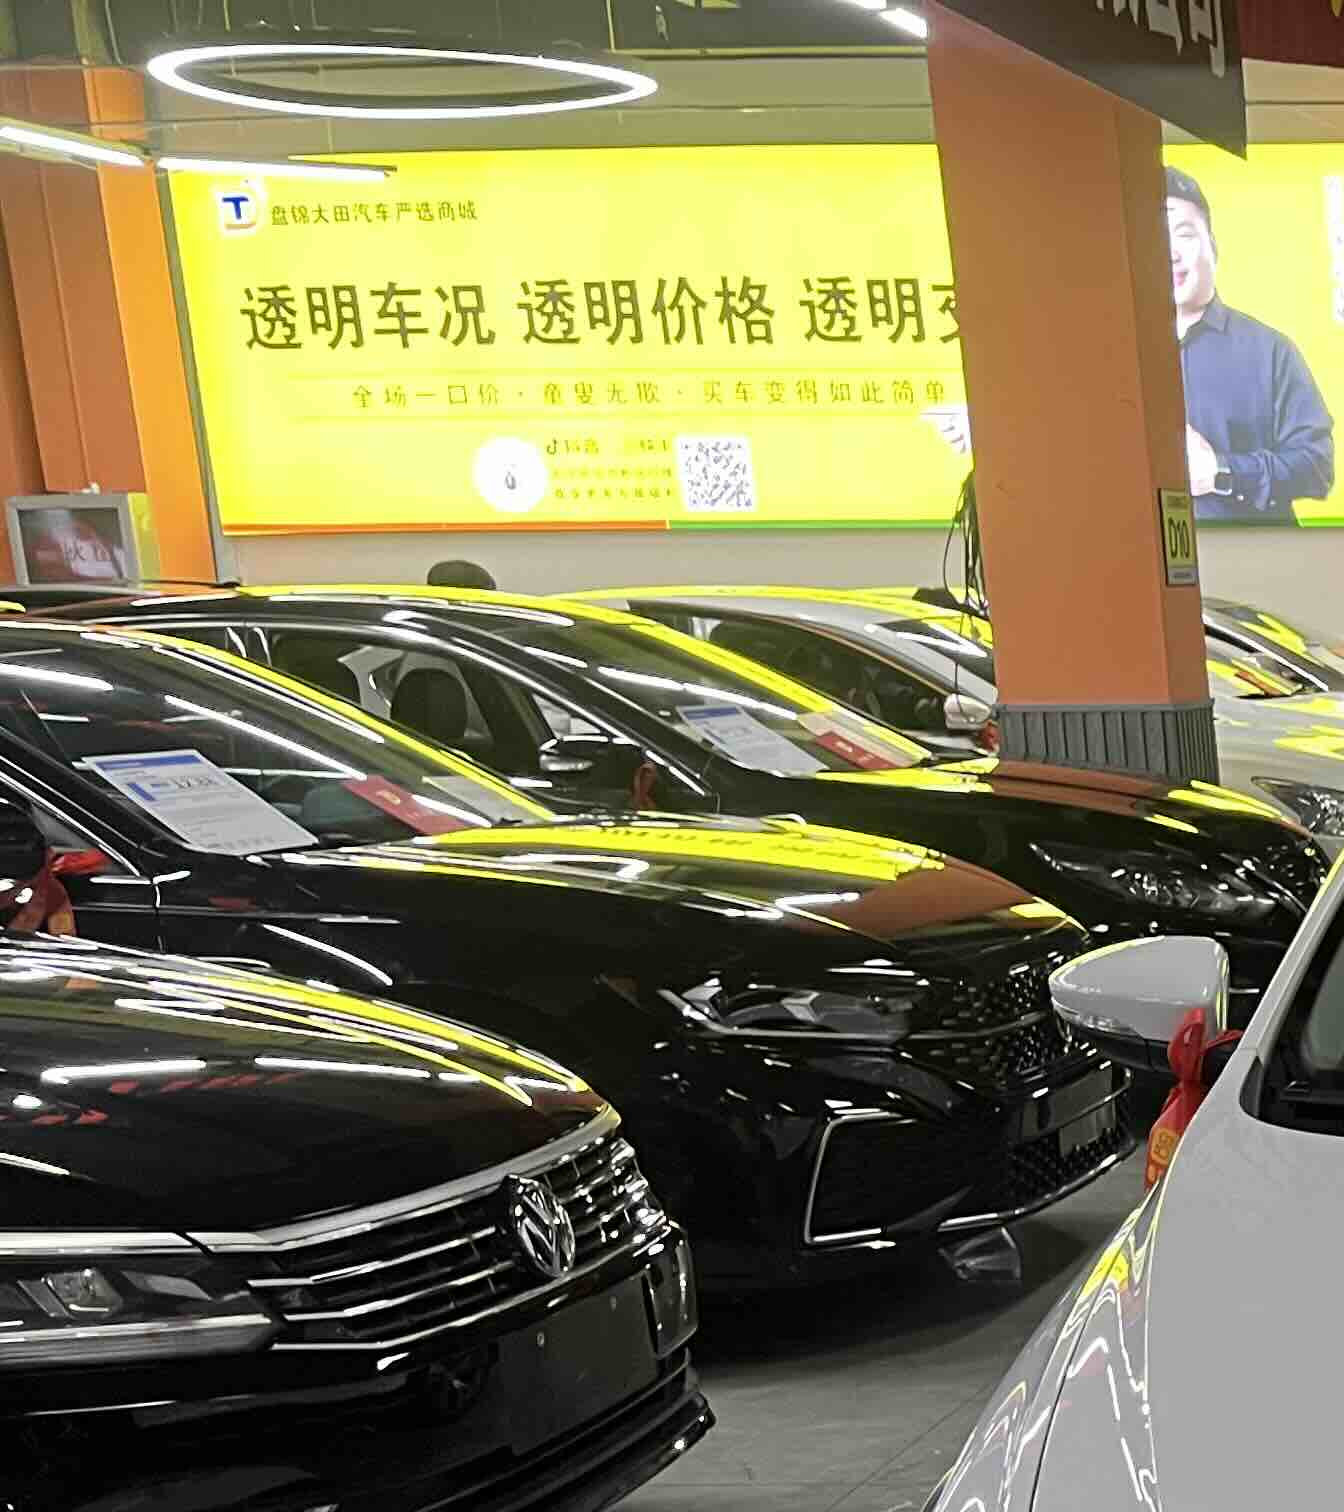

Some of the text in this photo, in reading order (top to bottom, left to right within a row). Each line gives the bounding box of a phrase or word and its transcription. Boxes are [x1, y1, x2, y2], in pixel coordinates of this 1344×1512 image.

[271, 200, 478, 226] 盘锦大田汽车严选商城
[240, 284, 495, 349] 透明车况
[517, 276, 777, 346] 透明价格
[1167, 516, 1190, 559] D10
